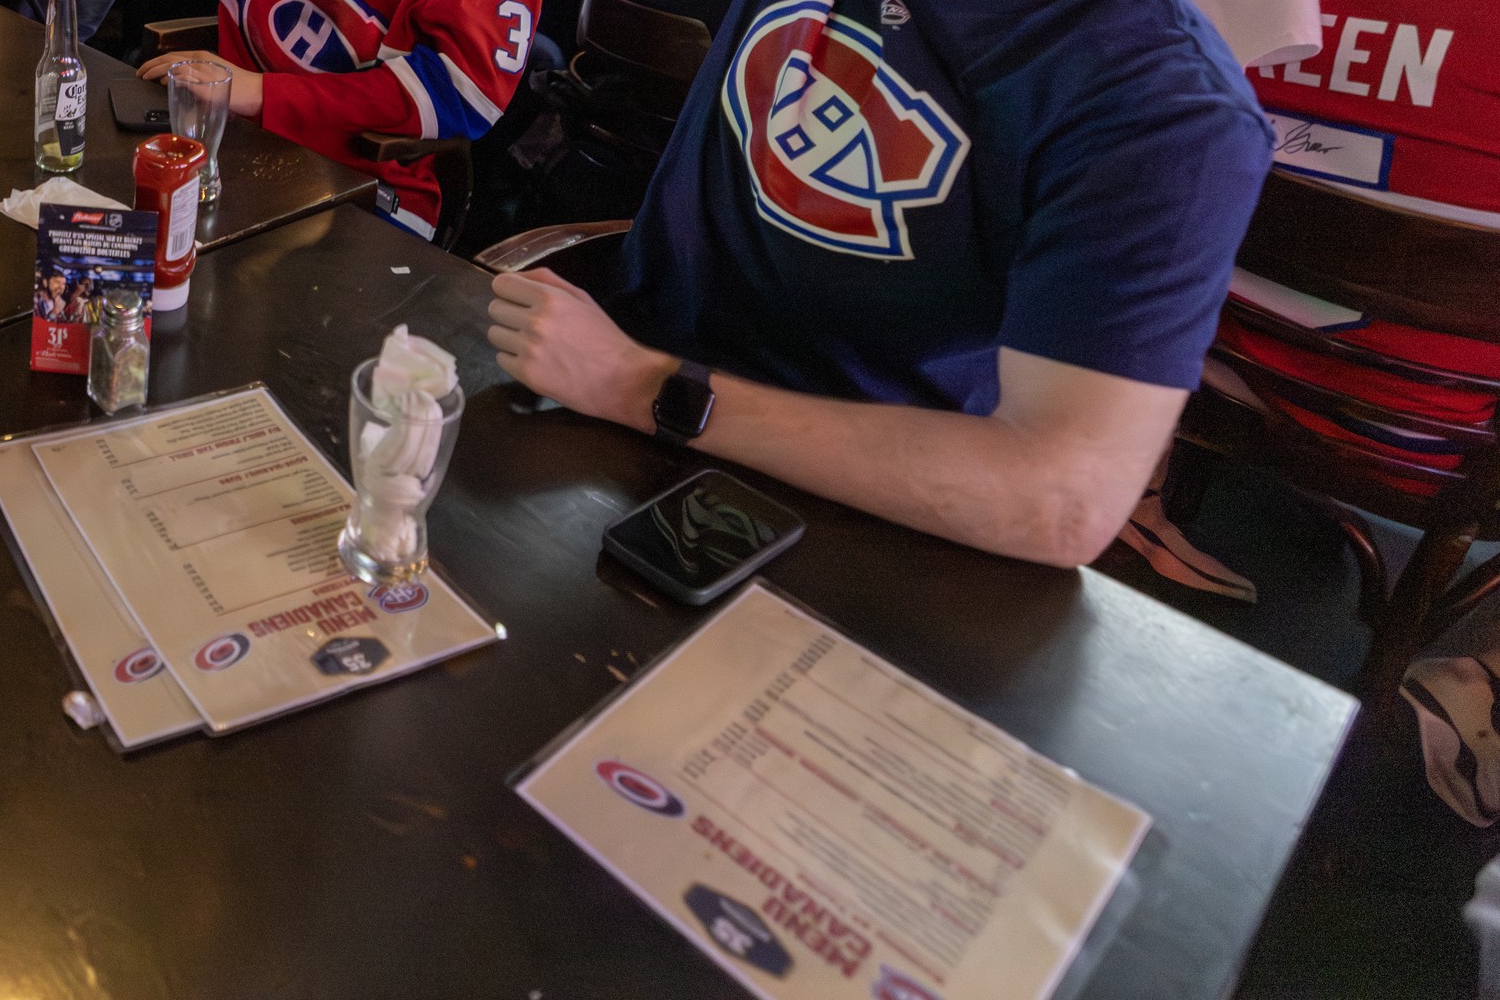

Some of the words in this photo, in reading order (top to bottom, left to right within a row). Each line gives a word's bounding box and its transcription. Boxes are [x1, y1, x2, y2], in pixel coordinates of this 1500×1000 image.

[494, 0, 534, 75] 3
[244, 589, 366, 639] CANADIENS
[314, 604, 379, 636] MENU
[691, 816, 873, 958] CANADIENS
[763, 896, 861, 979] MENU
